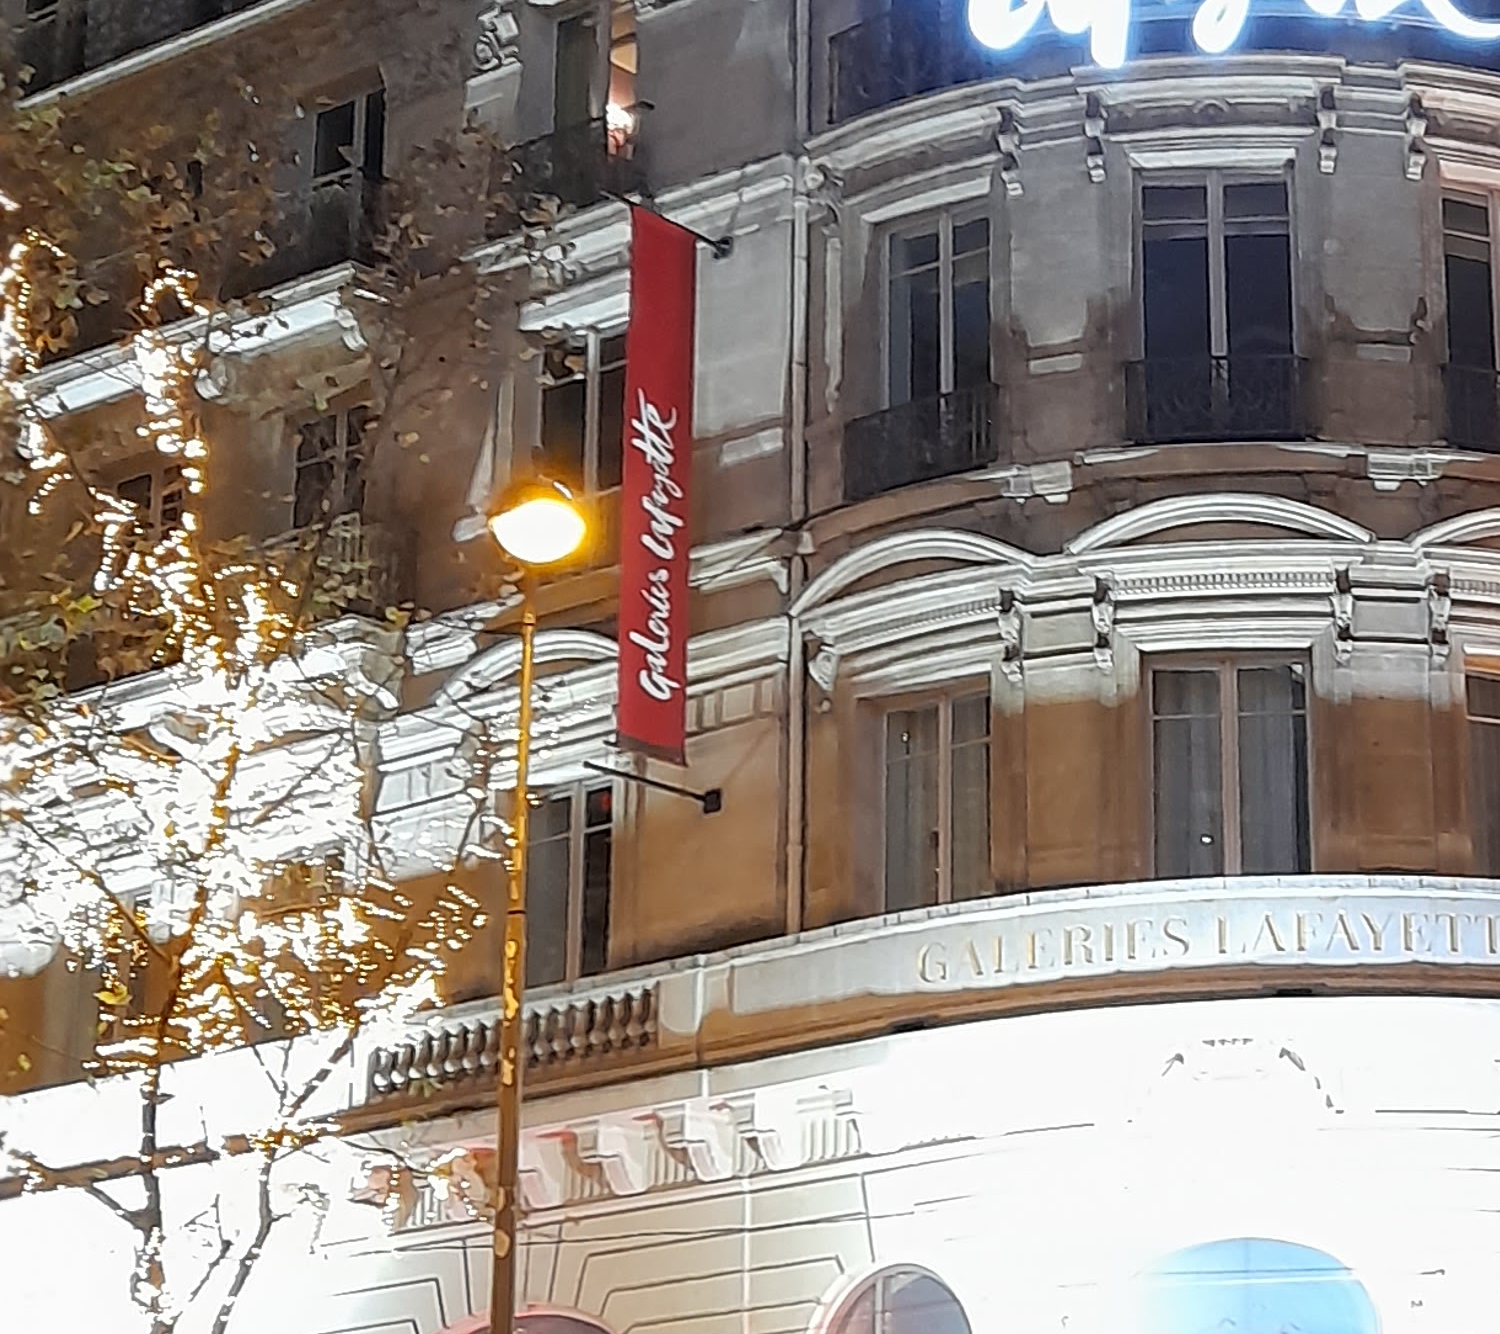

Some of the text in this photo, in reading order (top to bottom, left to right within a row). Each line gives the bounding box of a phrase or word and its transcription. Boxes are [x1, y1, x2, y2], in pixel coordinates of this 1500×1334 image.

[628, 387, 685, 701] Galeries Lafayette
[917, 917, 1190, 983] GALERIES
